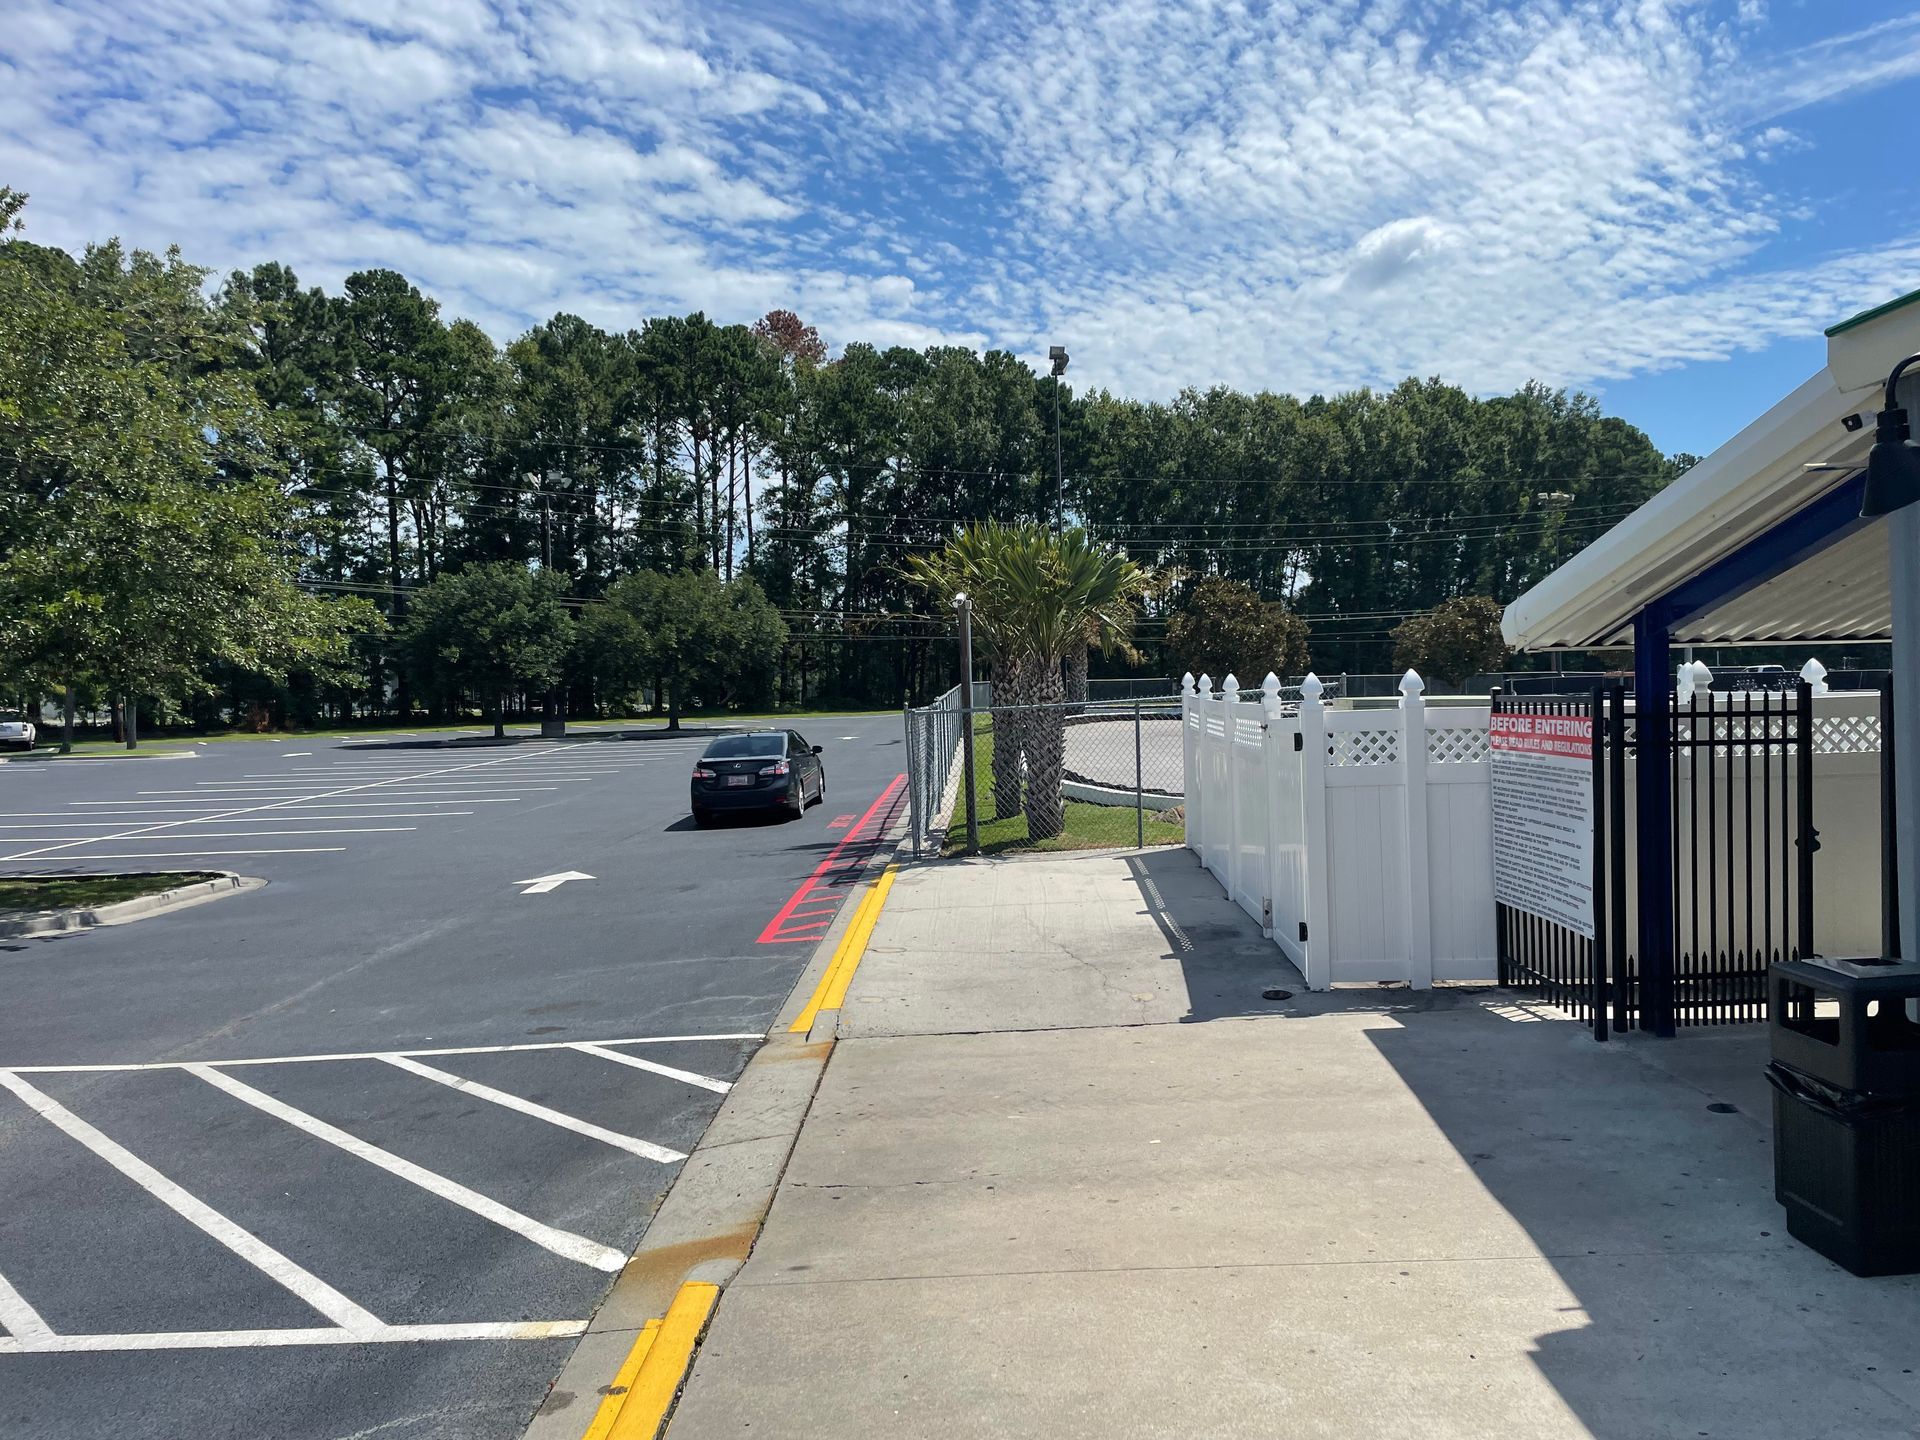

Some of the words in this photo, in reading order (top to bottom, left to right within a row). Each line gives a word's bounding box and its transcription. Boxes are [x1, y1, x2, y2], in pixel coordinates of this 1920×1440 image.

[1490, 716, 1532, 733] BEFORE
[1535, 718, 1592, 738] ENTERING
[1541, 739, 1553, 751] AND
[1554, 740, 1592, 755] REGULATIONS
